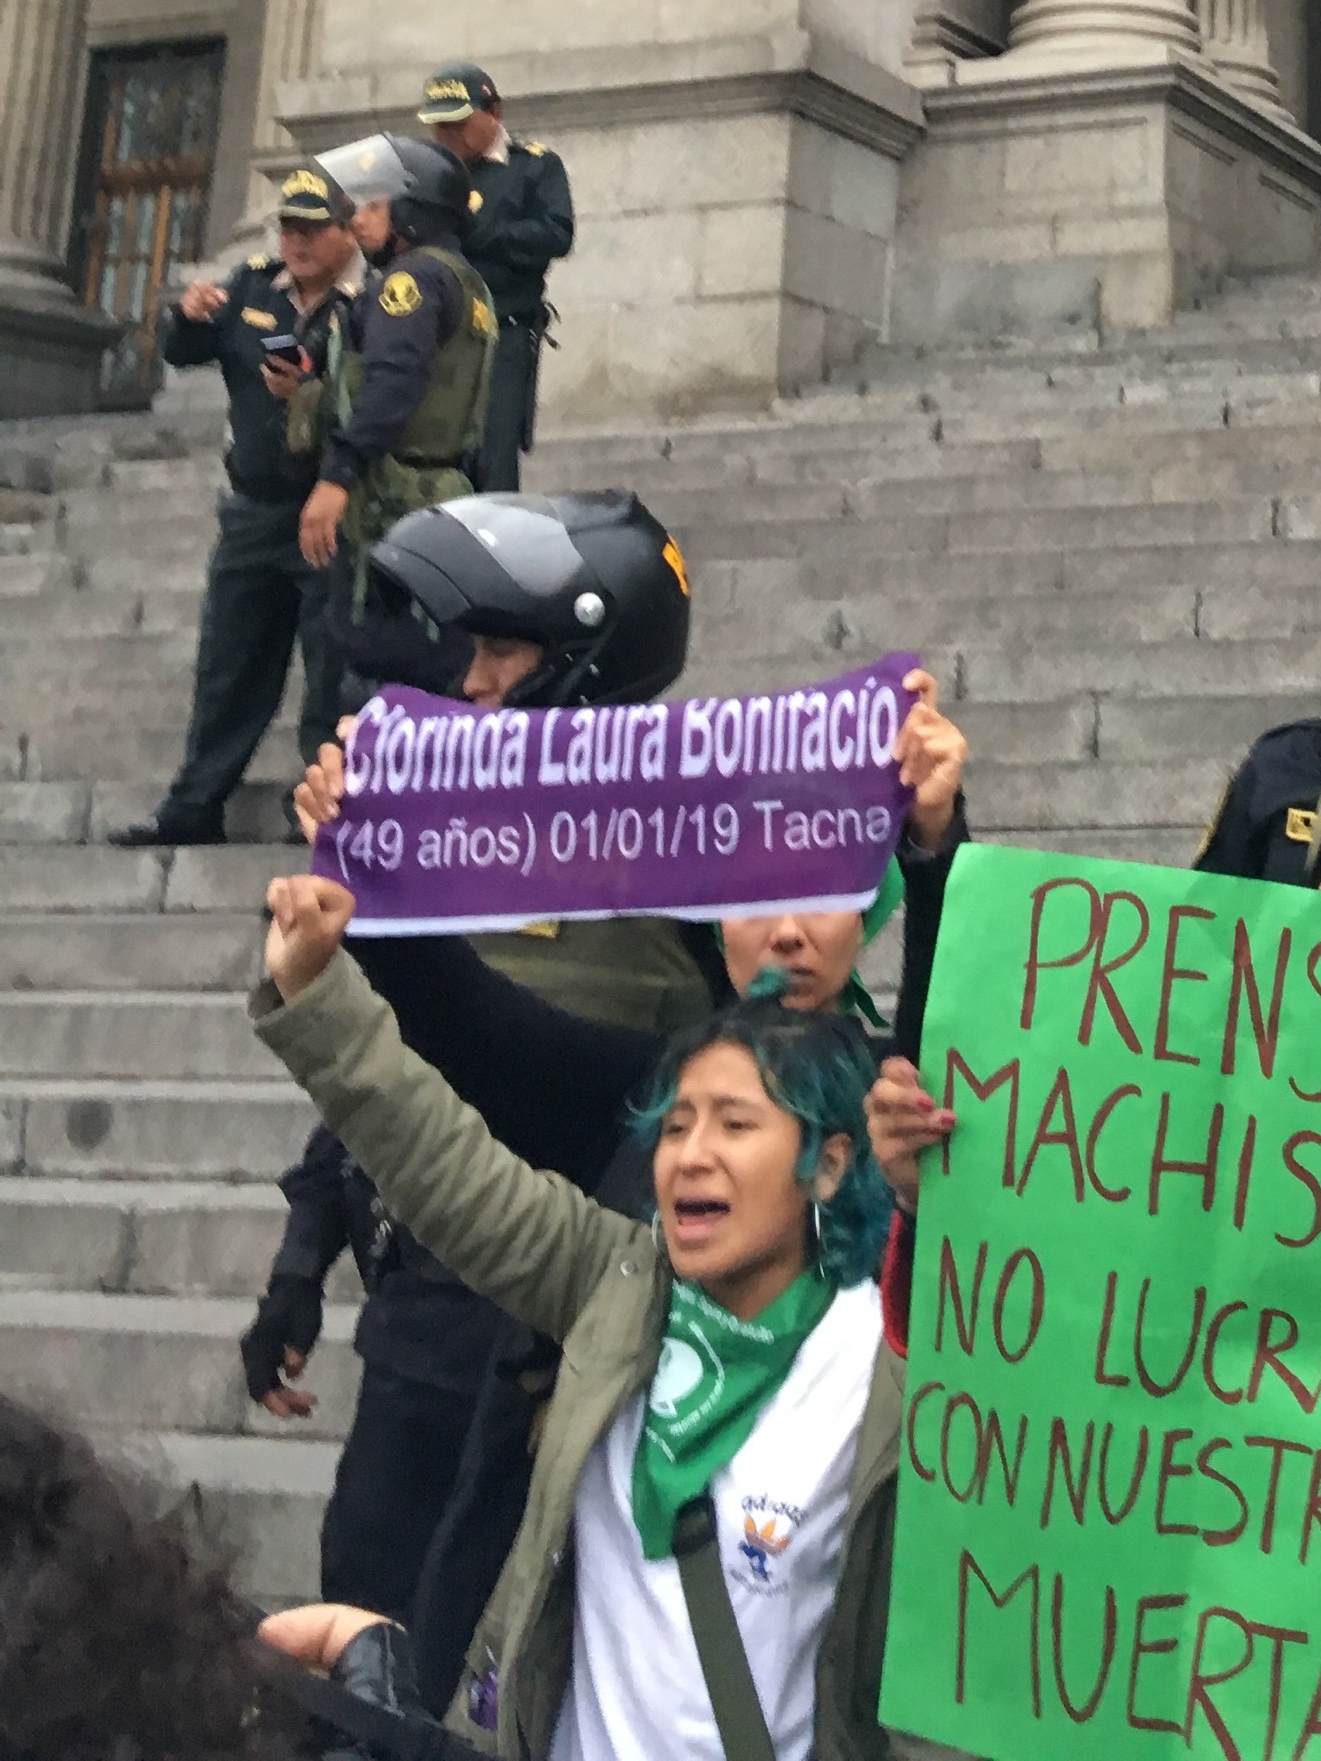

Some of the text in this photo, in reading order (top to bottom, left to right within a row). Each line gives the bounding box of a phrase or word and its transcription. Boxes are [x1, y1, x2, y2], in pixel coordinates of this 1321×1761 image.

[538, 703, 669, 786] Laura
[679, 676, 899, 780] Bonifacio
[336, 798, 892, 881] (49 años) 01/01/19 Tacna
[935, 1236, 1045, 1364] NO
[907, 1381, 1029, 1509] CON
